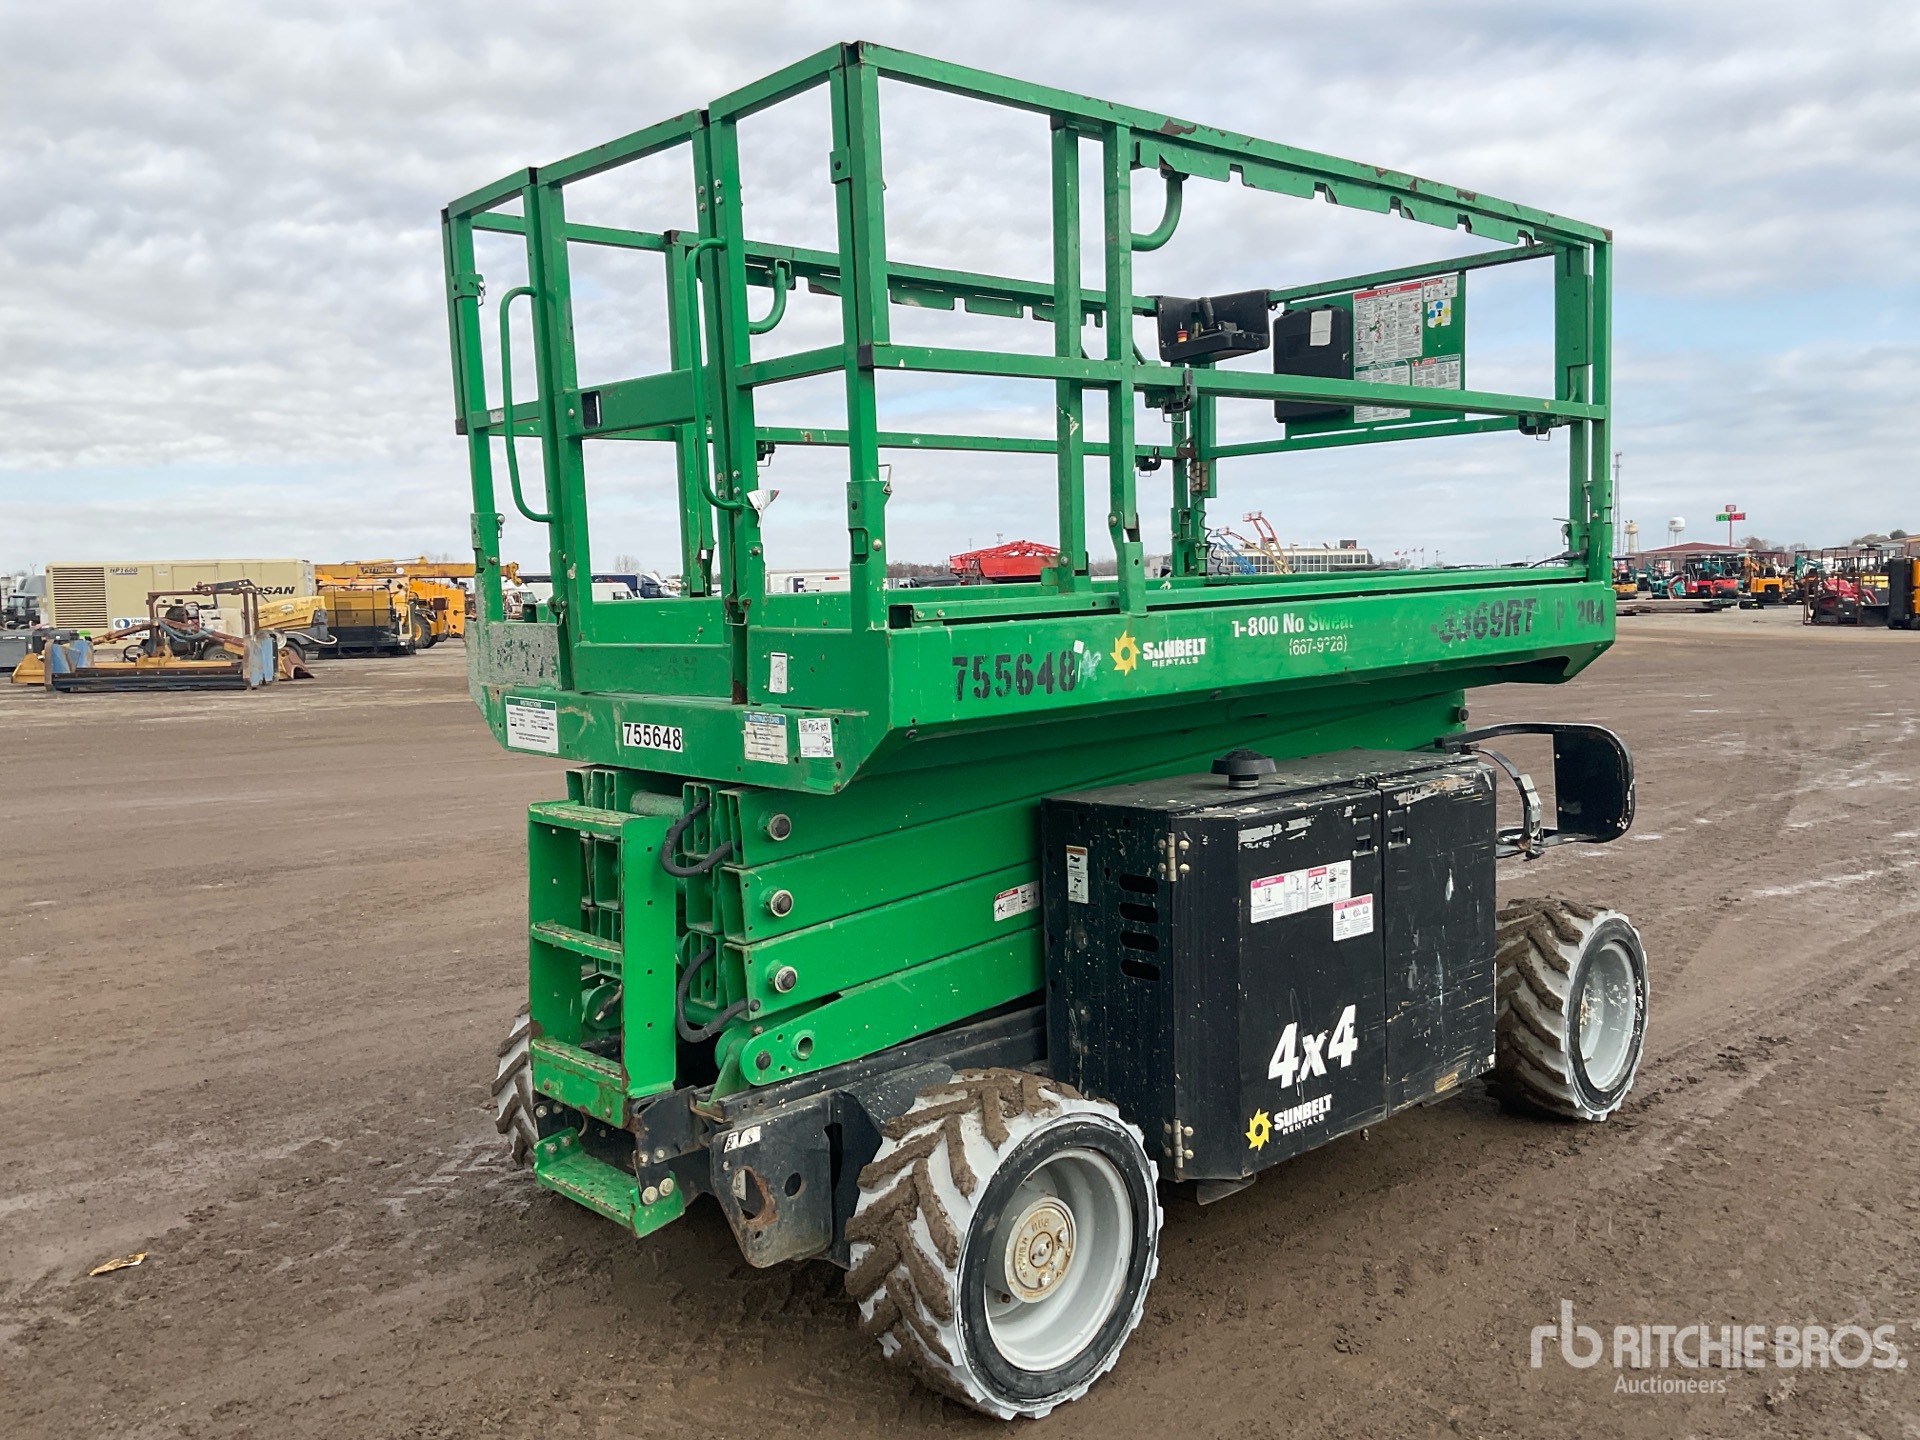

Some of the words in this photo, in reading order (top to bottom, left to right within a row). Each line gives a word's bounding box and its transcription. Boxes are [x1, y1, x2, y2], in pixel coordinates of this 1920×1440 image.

[1283, 613, 1305, 634] No
[952, 650, 1075, 701] 755648
[623, 722, 682, 752] 755648
[1268, 1004, 1358, 1089] 4x4
[1274, 1094, 1333, 1131] SUNBELT
[1283, 1113, 1325, 1136] RENTALS
